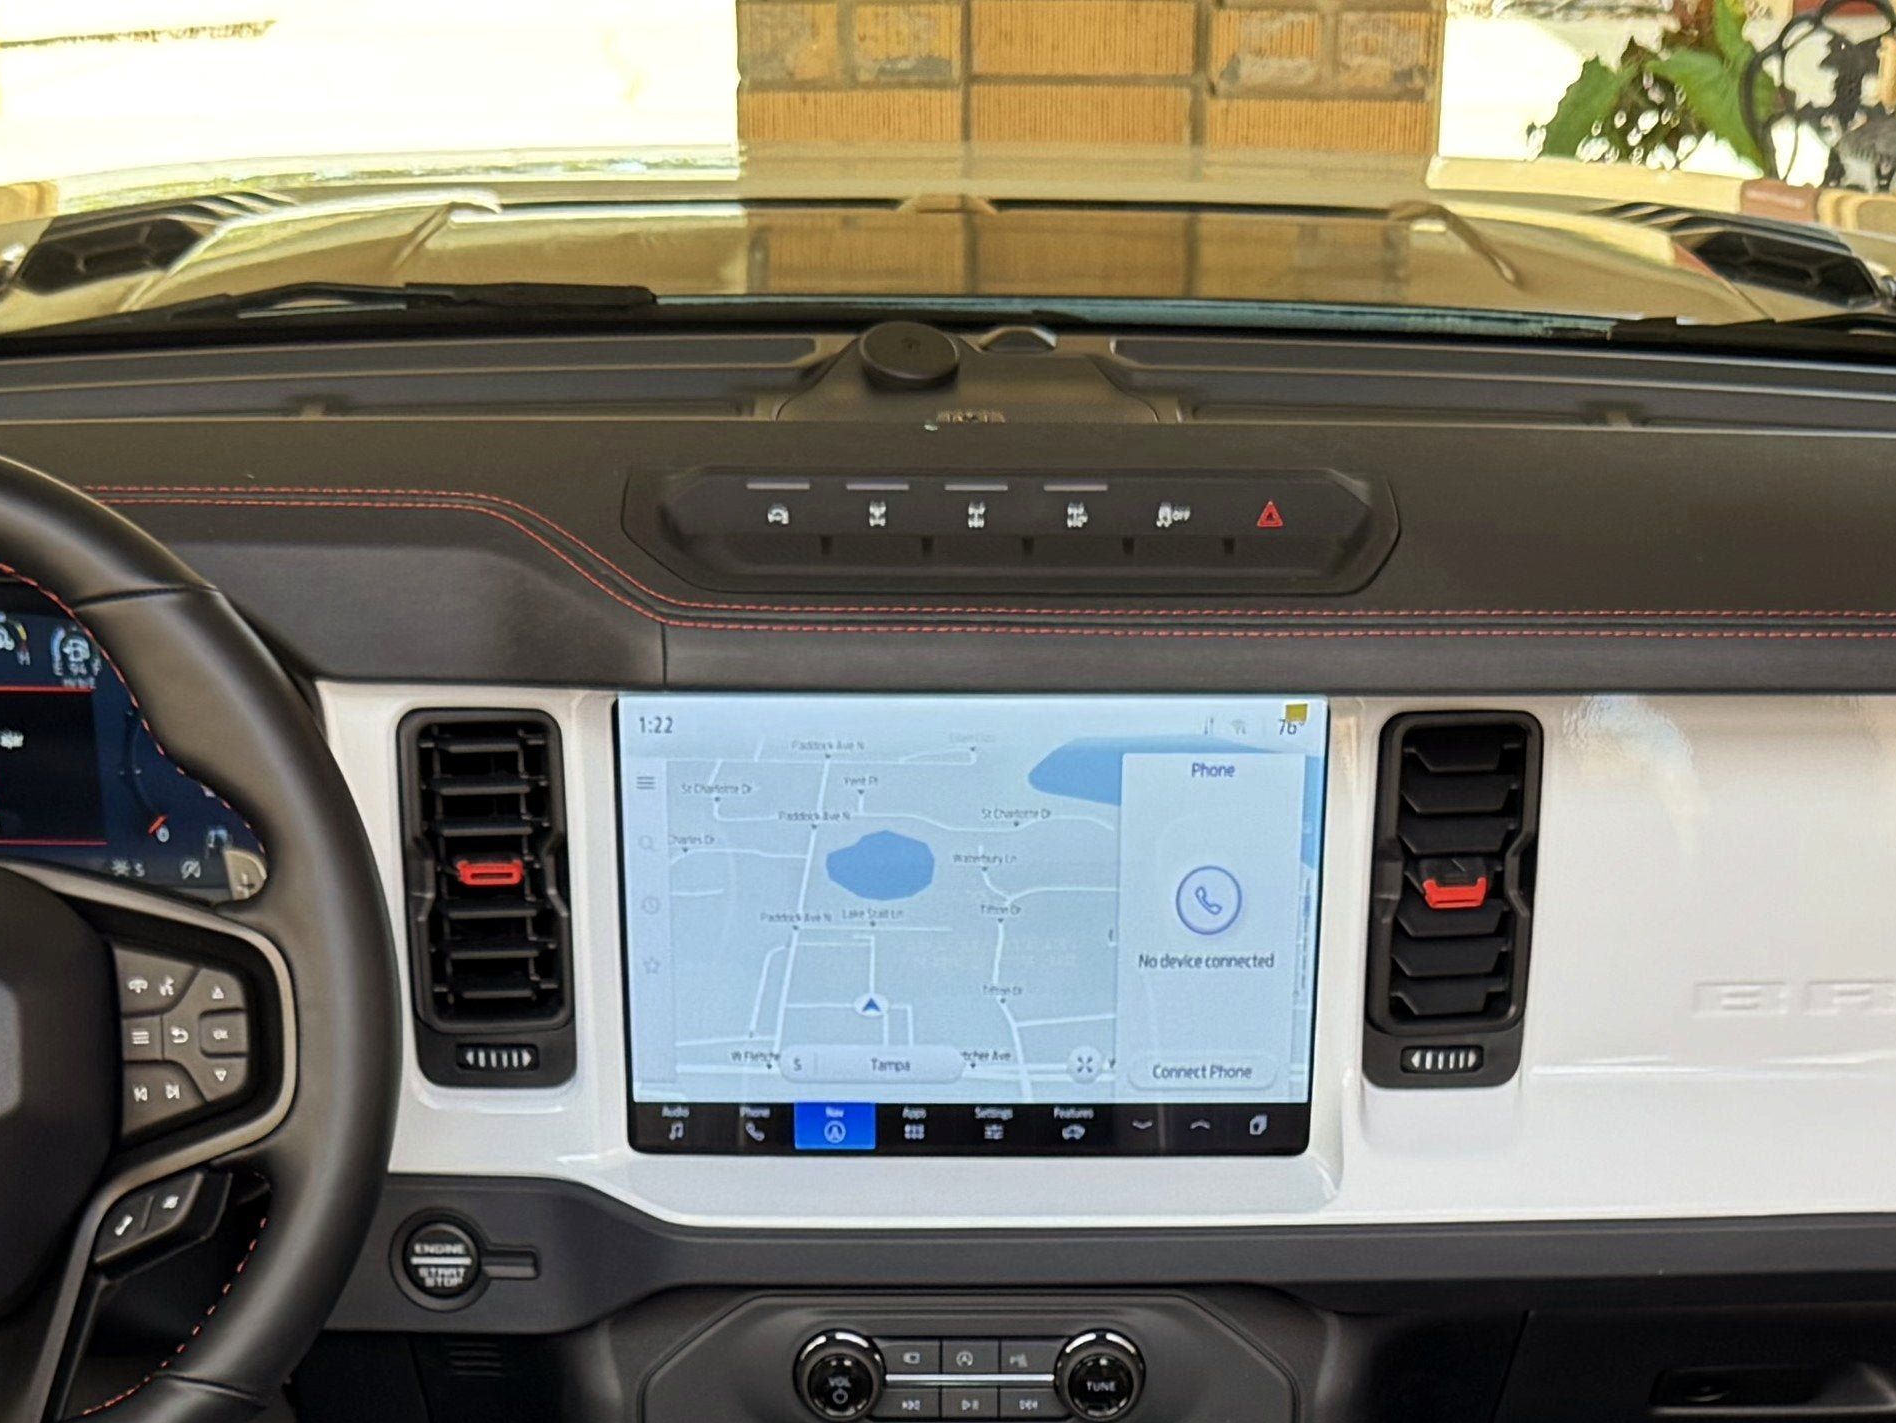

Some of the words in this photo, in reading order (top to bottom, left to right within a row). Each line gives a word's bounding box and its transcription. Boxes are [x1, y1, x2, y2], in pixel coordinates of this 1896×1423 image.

[638, 715, 674, 735] 1:22
[1191, 762, 1236, 779] Phone
[1138, 955, 1157, 968] No
[1161, 954, 1202, 968] device
[1205, 954, 1275, 969] connected
[212, 1028, 229, 1040] OK
[744, 1052, 781, 1062] Fletche
[793, 1058, 802, 1072] S
[870, 1057, 911, 1073] Tampa
[1153, 1064, 1206, 1081] Connect
[1209, 1064, 1253, 1081] Phone
[828, 1377, 851, 1388] VOL
[1086, 1381, 1117, 1393] TUNE
